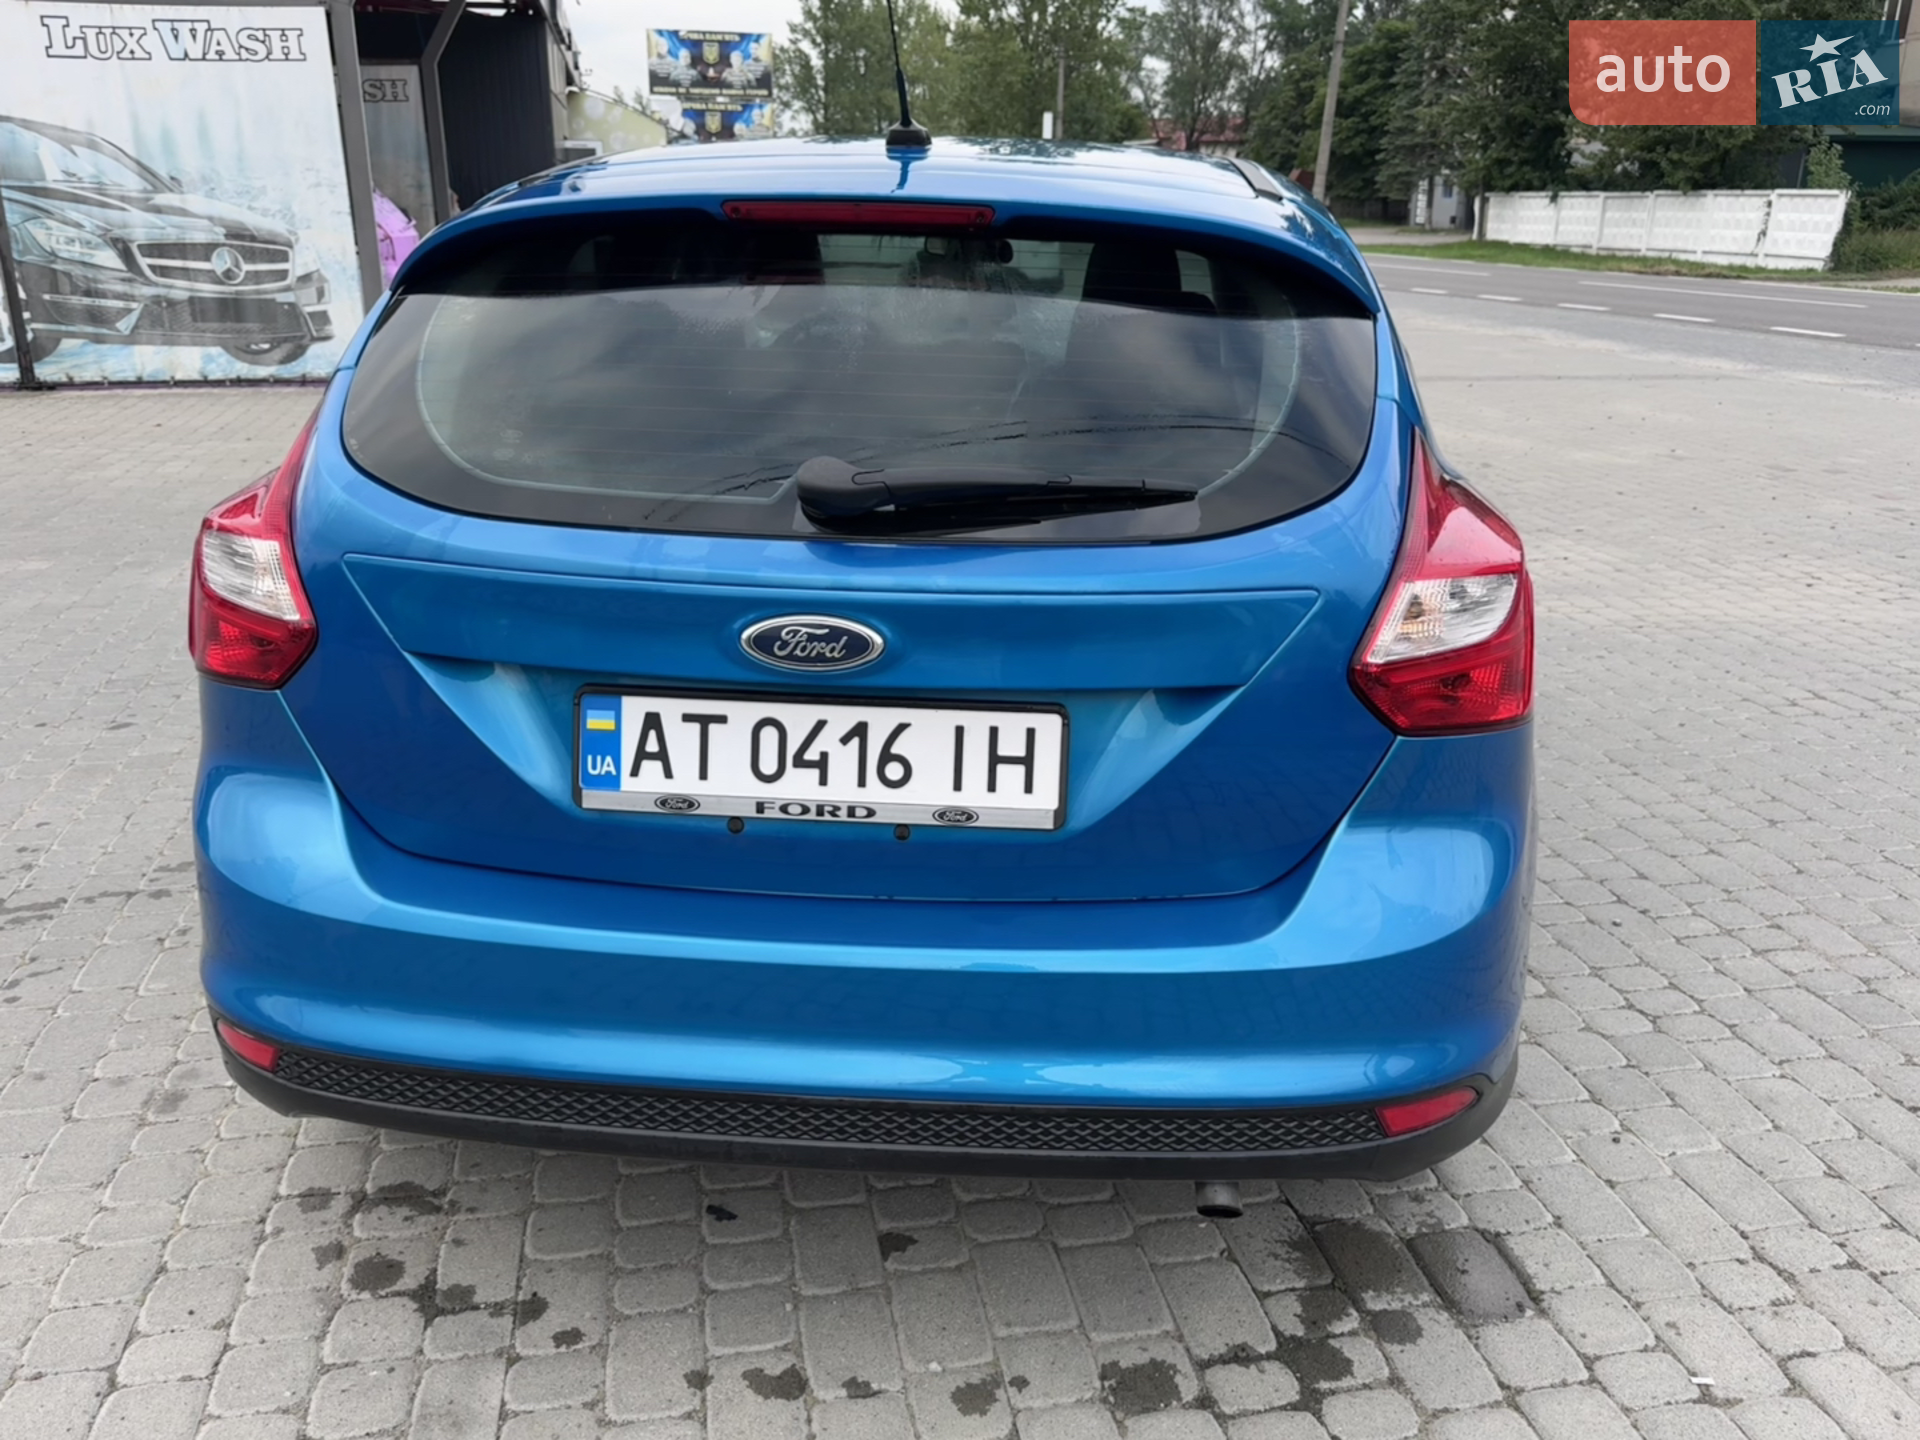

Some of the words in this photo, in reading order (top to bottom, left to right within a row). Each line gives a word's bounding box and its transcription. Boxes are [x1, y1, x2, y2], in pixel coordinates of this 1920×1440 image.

[362, 78, 409, 103] SH
[774, 626, 847, 659] Ford
[587, 755, 616, 776] UA
[629, 711, 728, 780] AT
[750, 717, 913, 789] 0416
[953, 725, 1037, 795] IH
[755, 801, 877, 819] FORD
